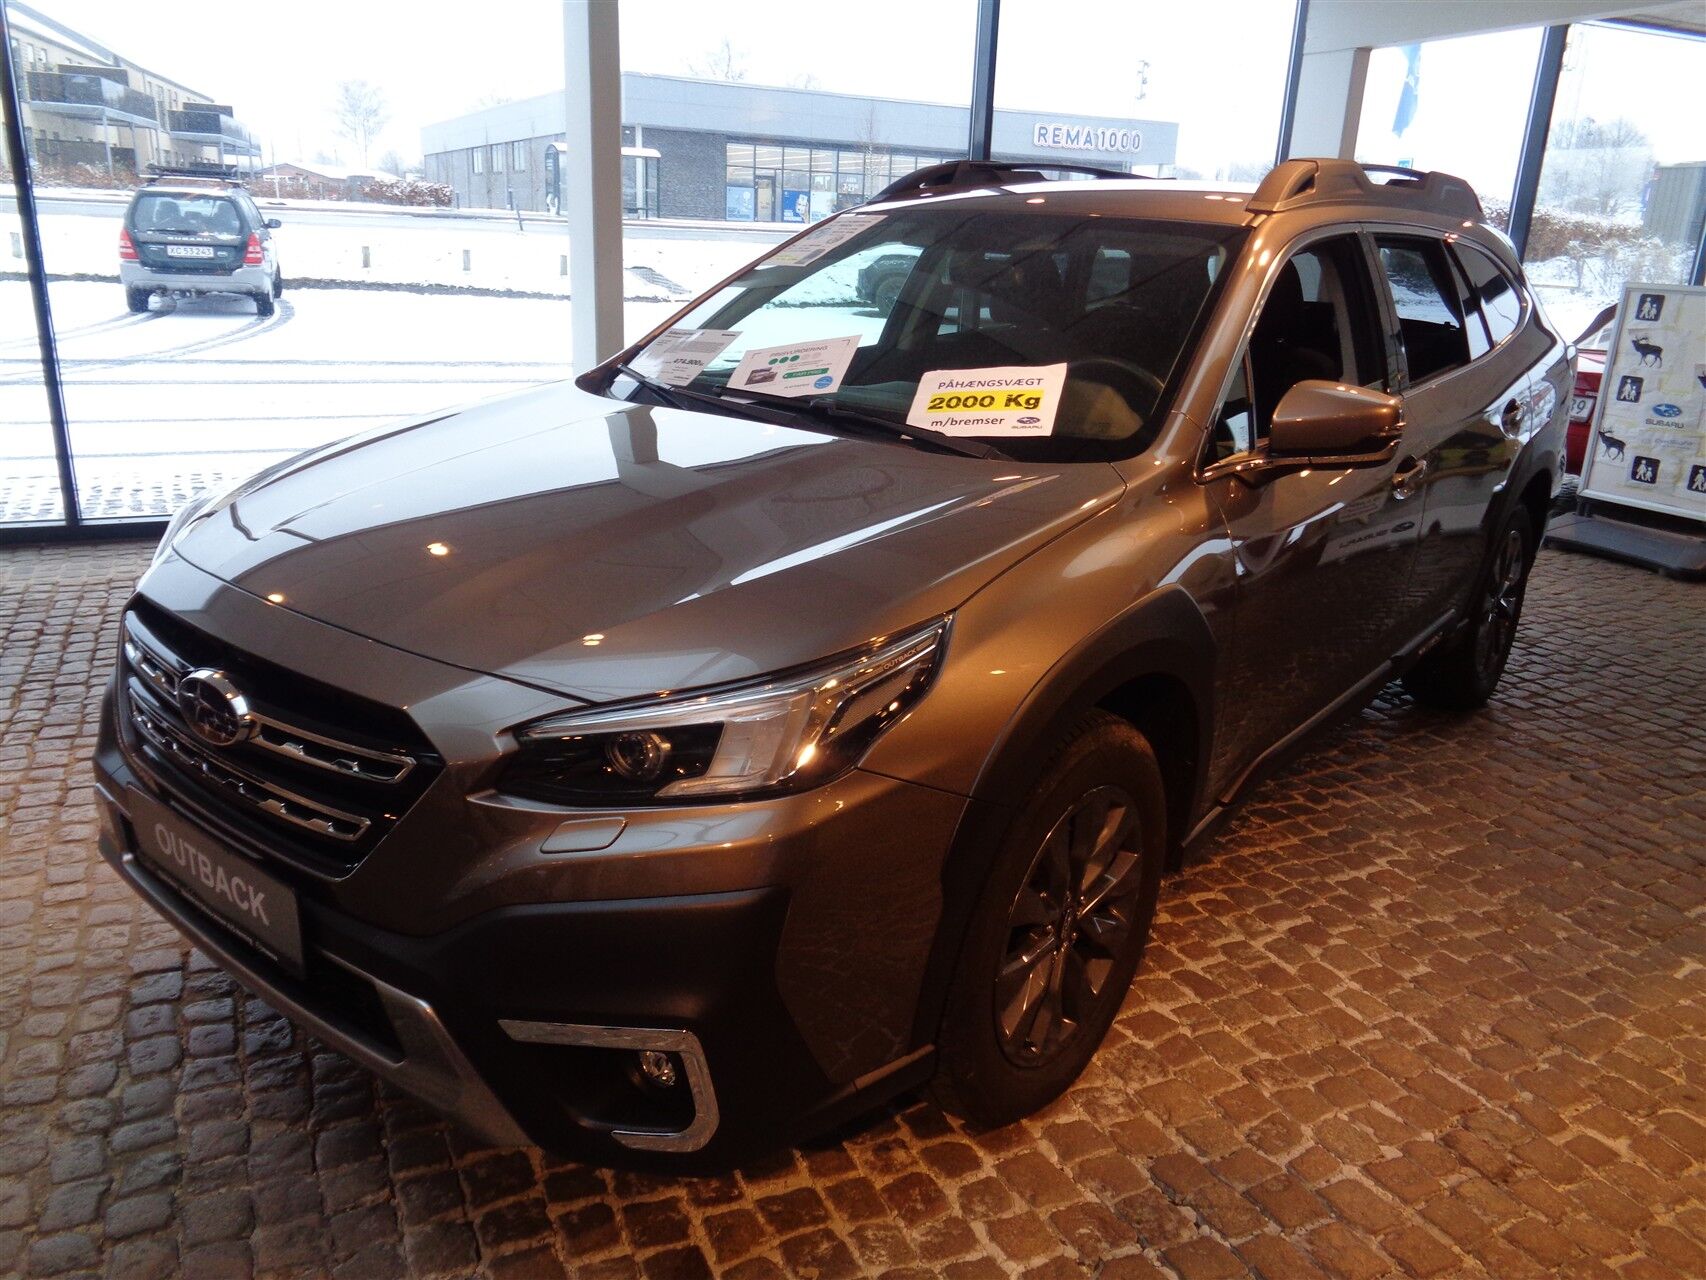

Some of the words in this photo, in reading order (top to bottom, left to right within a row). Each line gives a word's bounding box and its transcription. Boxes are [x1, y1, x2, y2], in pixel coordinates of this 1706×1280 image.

[1036, 125, 1094, 148] REMA
[1098, 129, 1141, 151] 1000
[938, 378, 1044, 390] PÅHÆNGSVÆGT
[927, 395, 995, 410] 2000
[1004, 393, 1041, 410] Kg
[930, 417, 1005, 427] m/bremser
[1645, 418, 1685, 429] SUBARU
[883, 649, 917, 670] OUTBACK
[154, 823, 270, 926] OUTBACK
